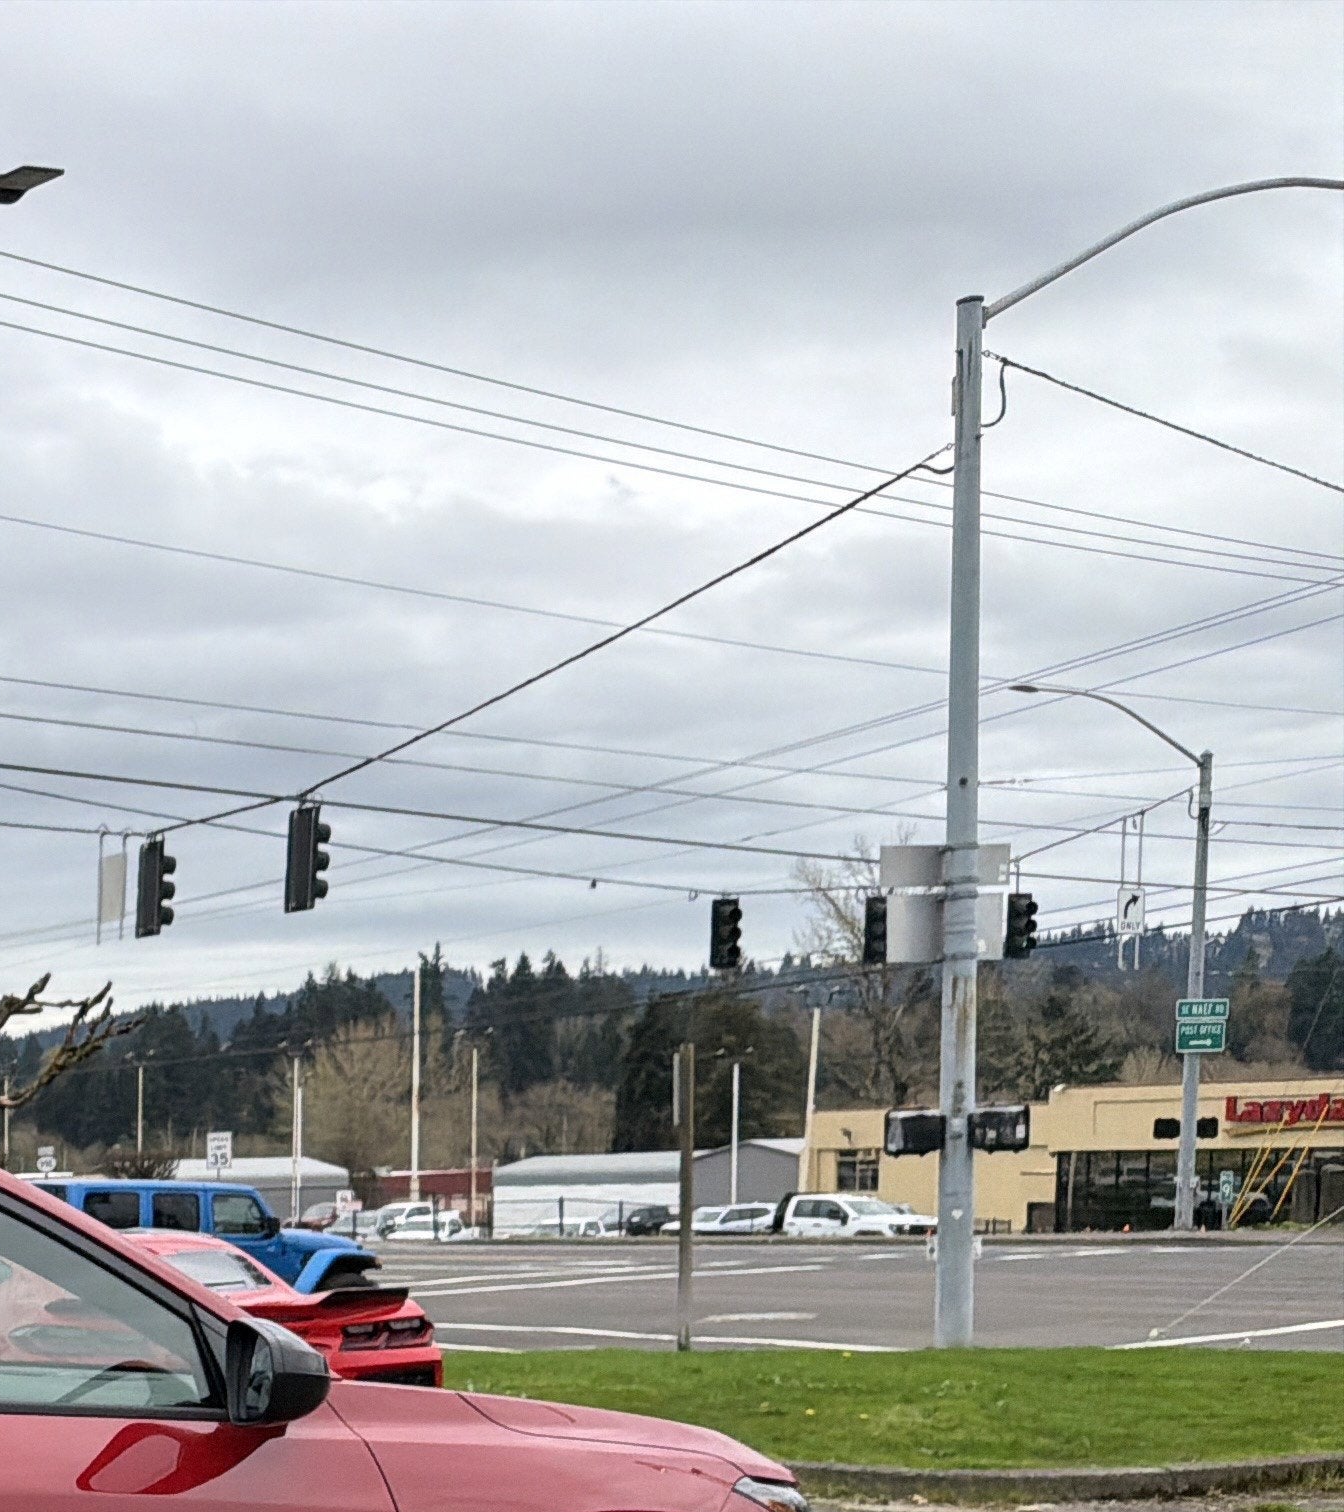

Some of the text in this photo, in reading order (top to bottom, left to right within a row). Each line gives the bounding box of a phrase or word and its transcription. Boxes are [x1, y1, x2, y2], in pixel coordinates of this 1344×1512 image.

[1120, 921, 1141, 931] ONLY
[1180, 1024, 1199, 1035] POST
[210, 1152, 229, 1166] 35
